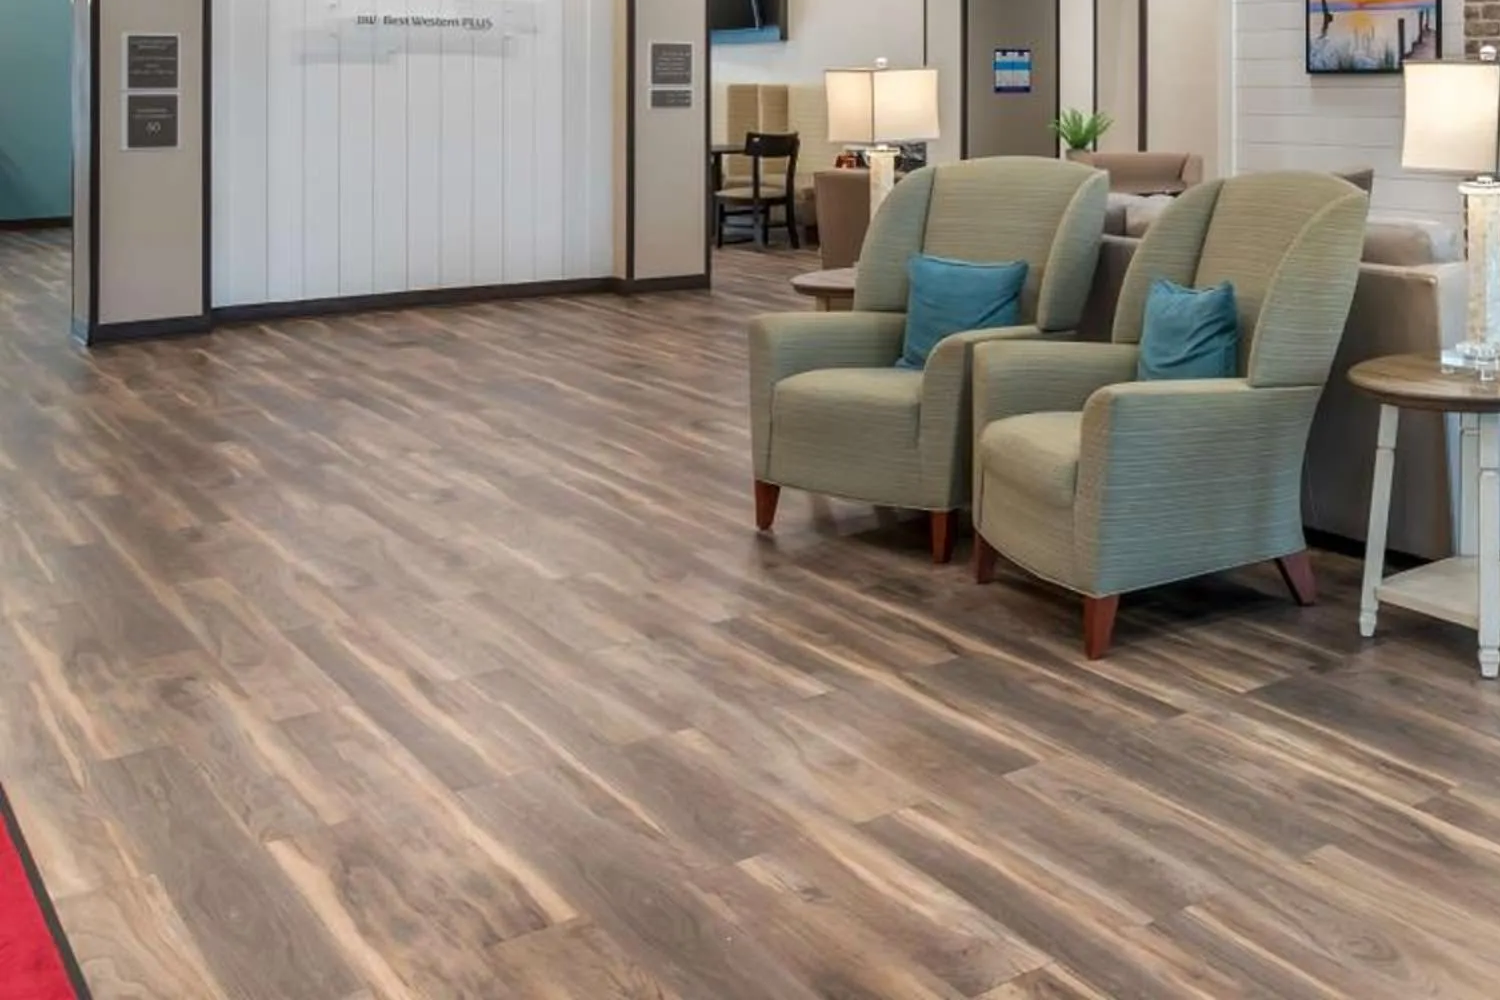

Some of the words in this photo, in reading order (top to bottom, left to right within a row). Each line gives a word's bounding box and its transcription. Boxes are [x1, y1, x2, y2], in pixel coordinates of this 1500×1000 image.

[383, 15, 410, 27] Best
[411, 15, 460, 28] Western
[462, 17, 494, 30] PLUS
